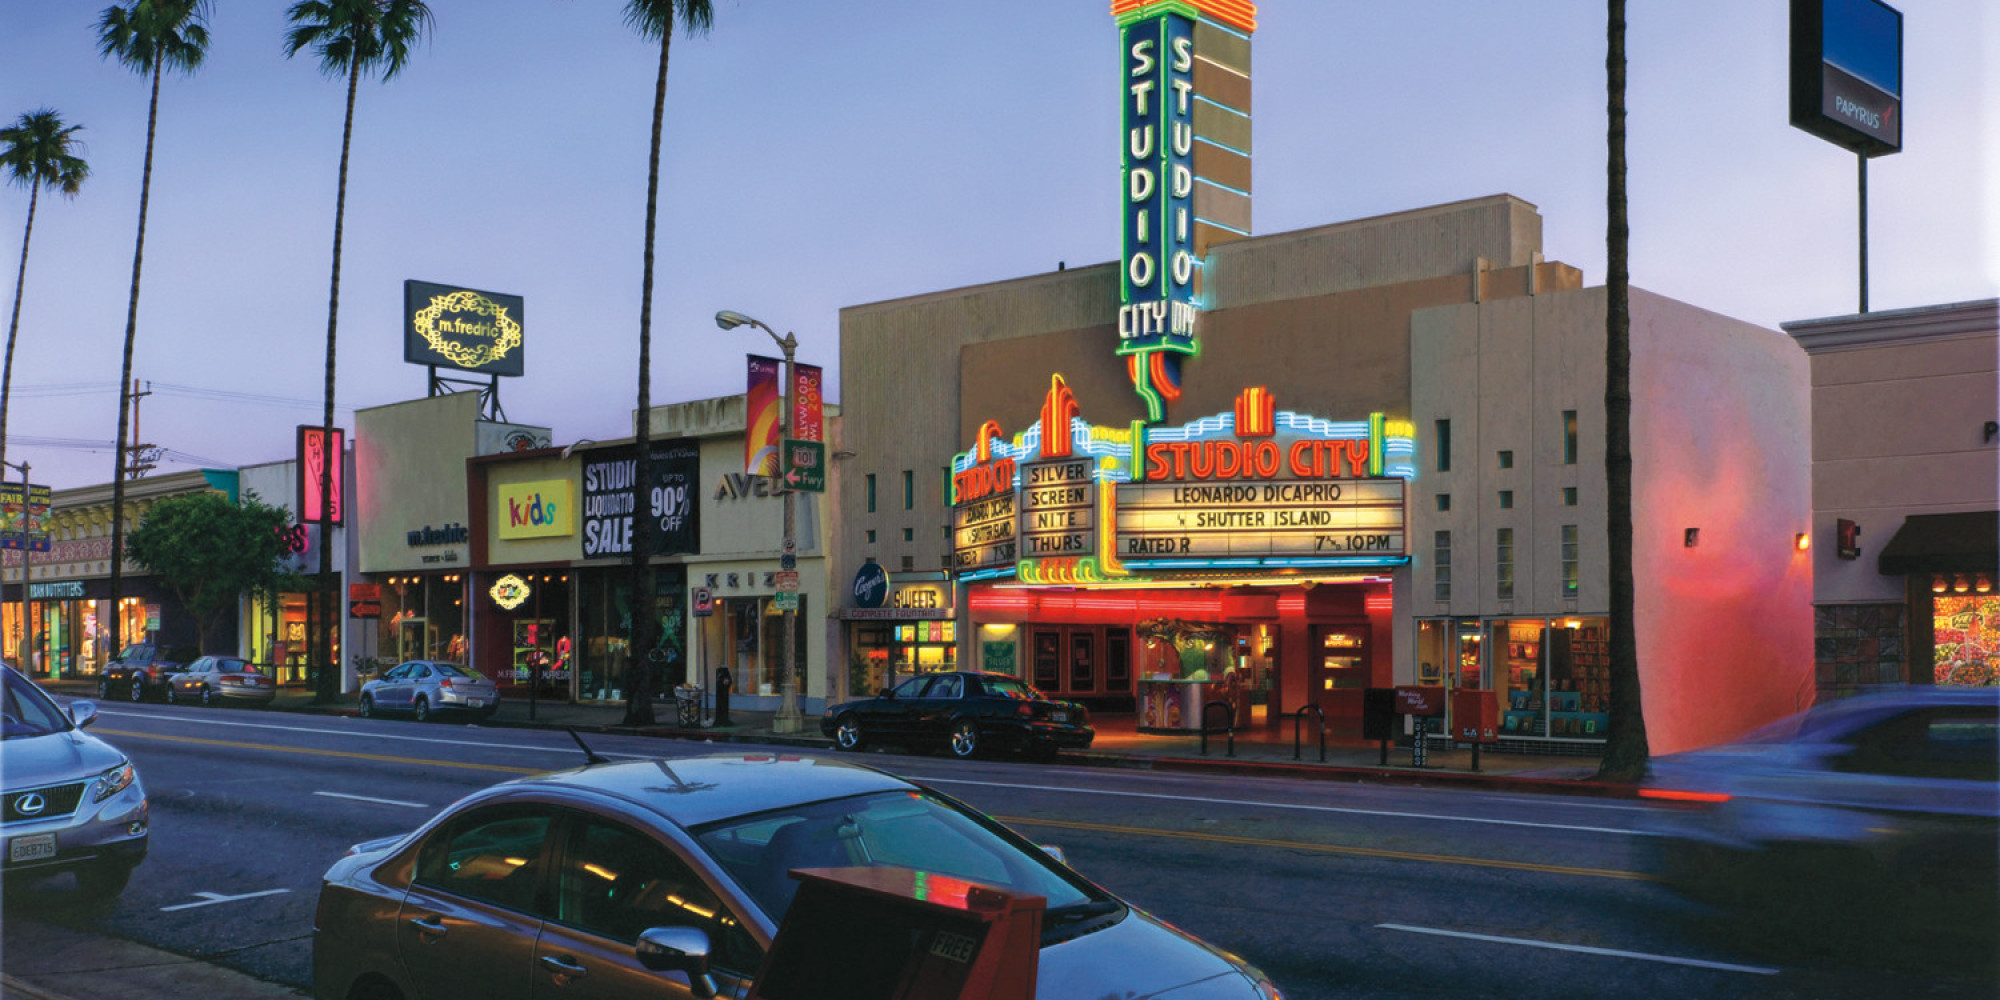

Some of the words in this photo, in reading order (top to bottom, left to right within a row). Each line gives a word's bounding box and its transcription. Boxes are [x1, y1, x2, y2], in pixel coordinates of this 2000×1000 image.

[1835, 95, 1880, 129] PAPYRUS
[1130, 39, 1155, 288] STUDIO
[1171, 36, 1193, 286] STUDIO
[440, 318, 499, 338] m.fredric
[1119, 300, 1167, 338] CITY
[798, 375, 809, 440] LLYWOOD
[797, 451, 813, 464] 101
[1147, 440, 1281, 480] STUDIO
[1289, 440, 1369, 477] CITY
[802, 472, 823, 488] Fwy
[1031, 464, 1085, 482] SILVER
[1, 493, 23, 504] FAIR
[651, 483, 690, 517] 90%
[1031, 487, 1085, 506] SCREEN
[1174, 486, 1257, 503] LEONARDO
[1264, 484, 1341, 502] DICAPRIO
[509, 493, 556, 528] kids
[585, 492, 635, 518] LIQUIDATIO
[661, 517, 682, 531] OFF
[1038, 511, 1076, 528] NITE
[1197, 511, 1265, 527] SHUTTER
[1274, 511, 1331, 526] ISLAND
[585, 517, 633, 555] SALE
[1030, 535, 1083, 552] THURS
[1128, 537, 1175, 553] RATED
[1180, 537, 1191, 553] R
[1316, 535, 1326, 551] 7
[895, 589, 936, 608] SWEETS
[931, 931, 976, 963] FREE
